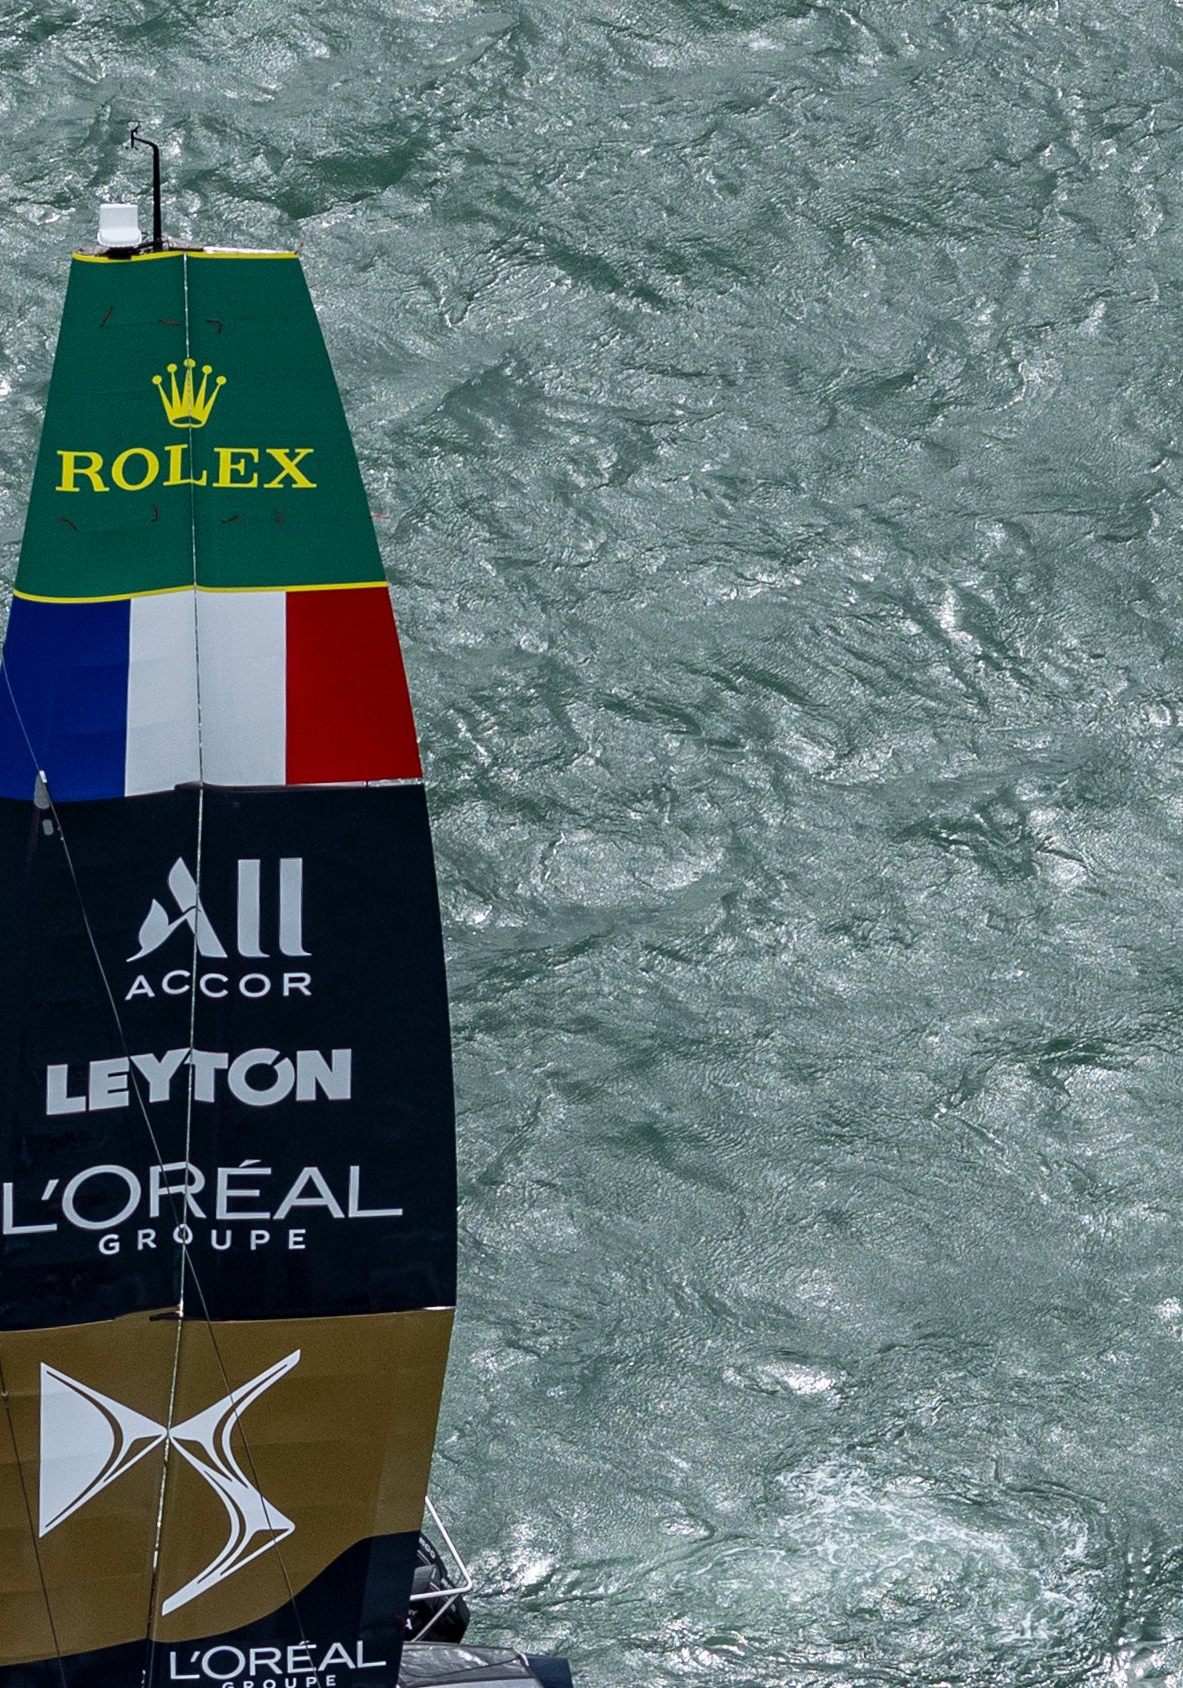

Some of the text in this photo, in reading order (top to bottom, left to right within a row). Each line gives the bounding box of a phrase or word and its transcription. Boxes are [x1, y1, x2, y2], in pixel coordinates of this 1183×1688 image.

[55, 444, 316, 492] ROLEX
[125, 970, 312, 1000] ACCOR
[46, 1048, 352, 1115] LEYTON
[3, 1159, 403, 1235] L'ORÉAL
[98, 1223, 306, 1255] GROUPE
[170, 1640, 386, 1680] L'ORÉAL
